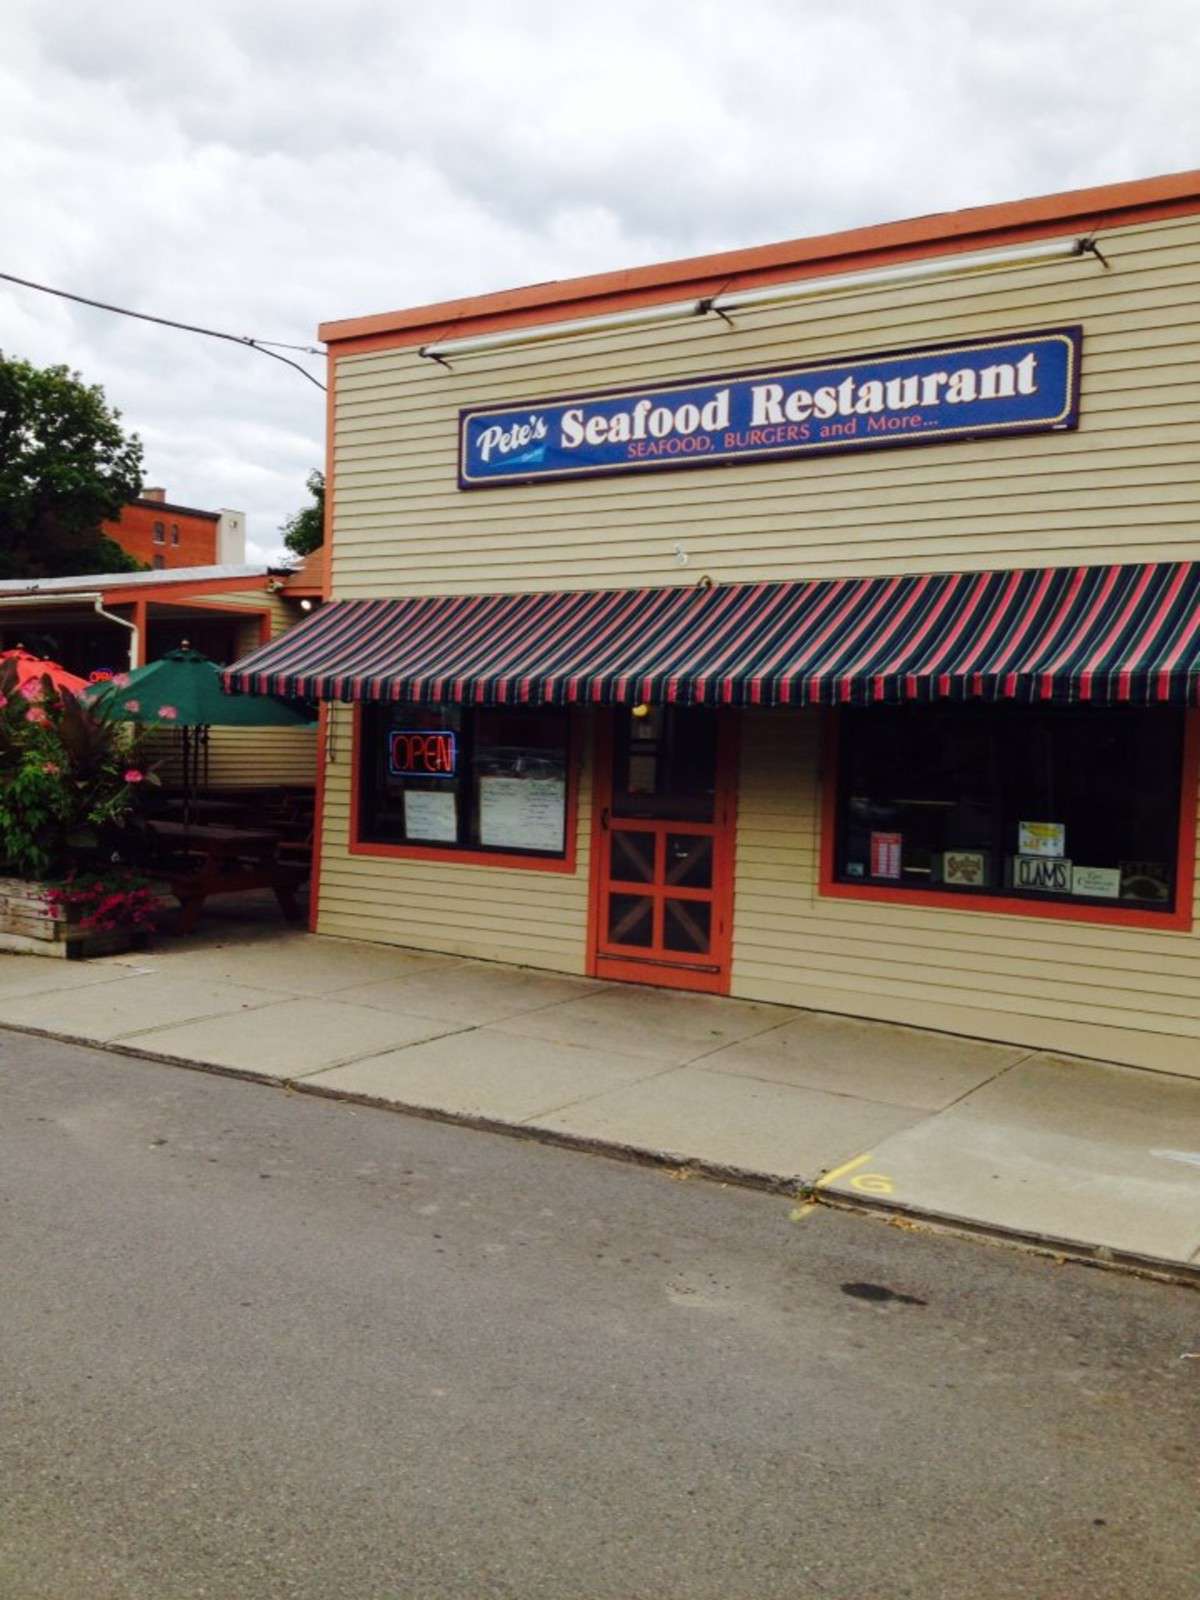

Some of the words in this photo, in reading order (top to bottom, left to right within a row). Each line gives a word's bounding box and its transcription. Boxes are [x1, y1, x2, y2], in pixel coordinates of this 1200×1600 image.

[560, 388, 731, 449] Seafood
[750, 352, 1038, 427] Restaurant
[476, 414, 548, 464] Pete's
[627, 434, 716, 459] SEAFOOD,
[723, 422, 811, 449] BURGERS
[819, 421, 857, 438] and
[867, 413, 939, 433] More...
[393, 735, 455, 772] OPEN
[1019, 859, 1067, 889] CLAMS
